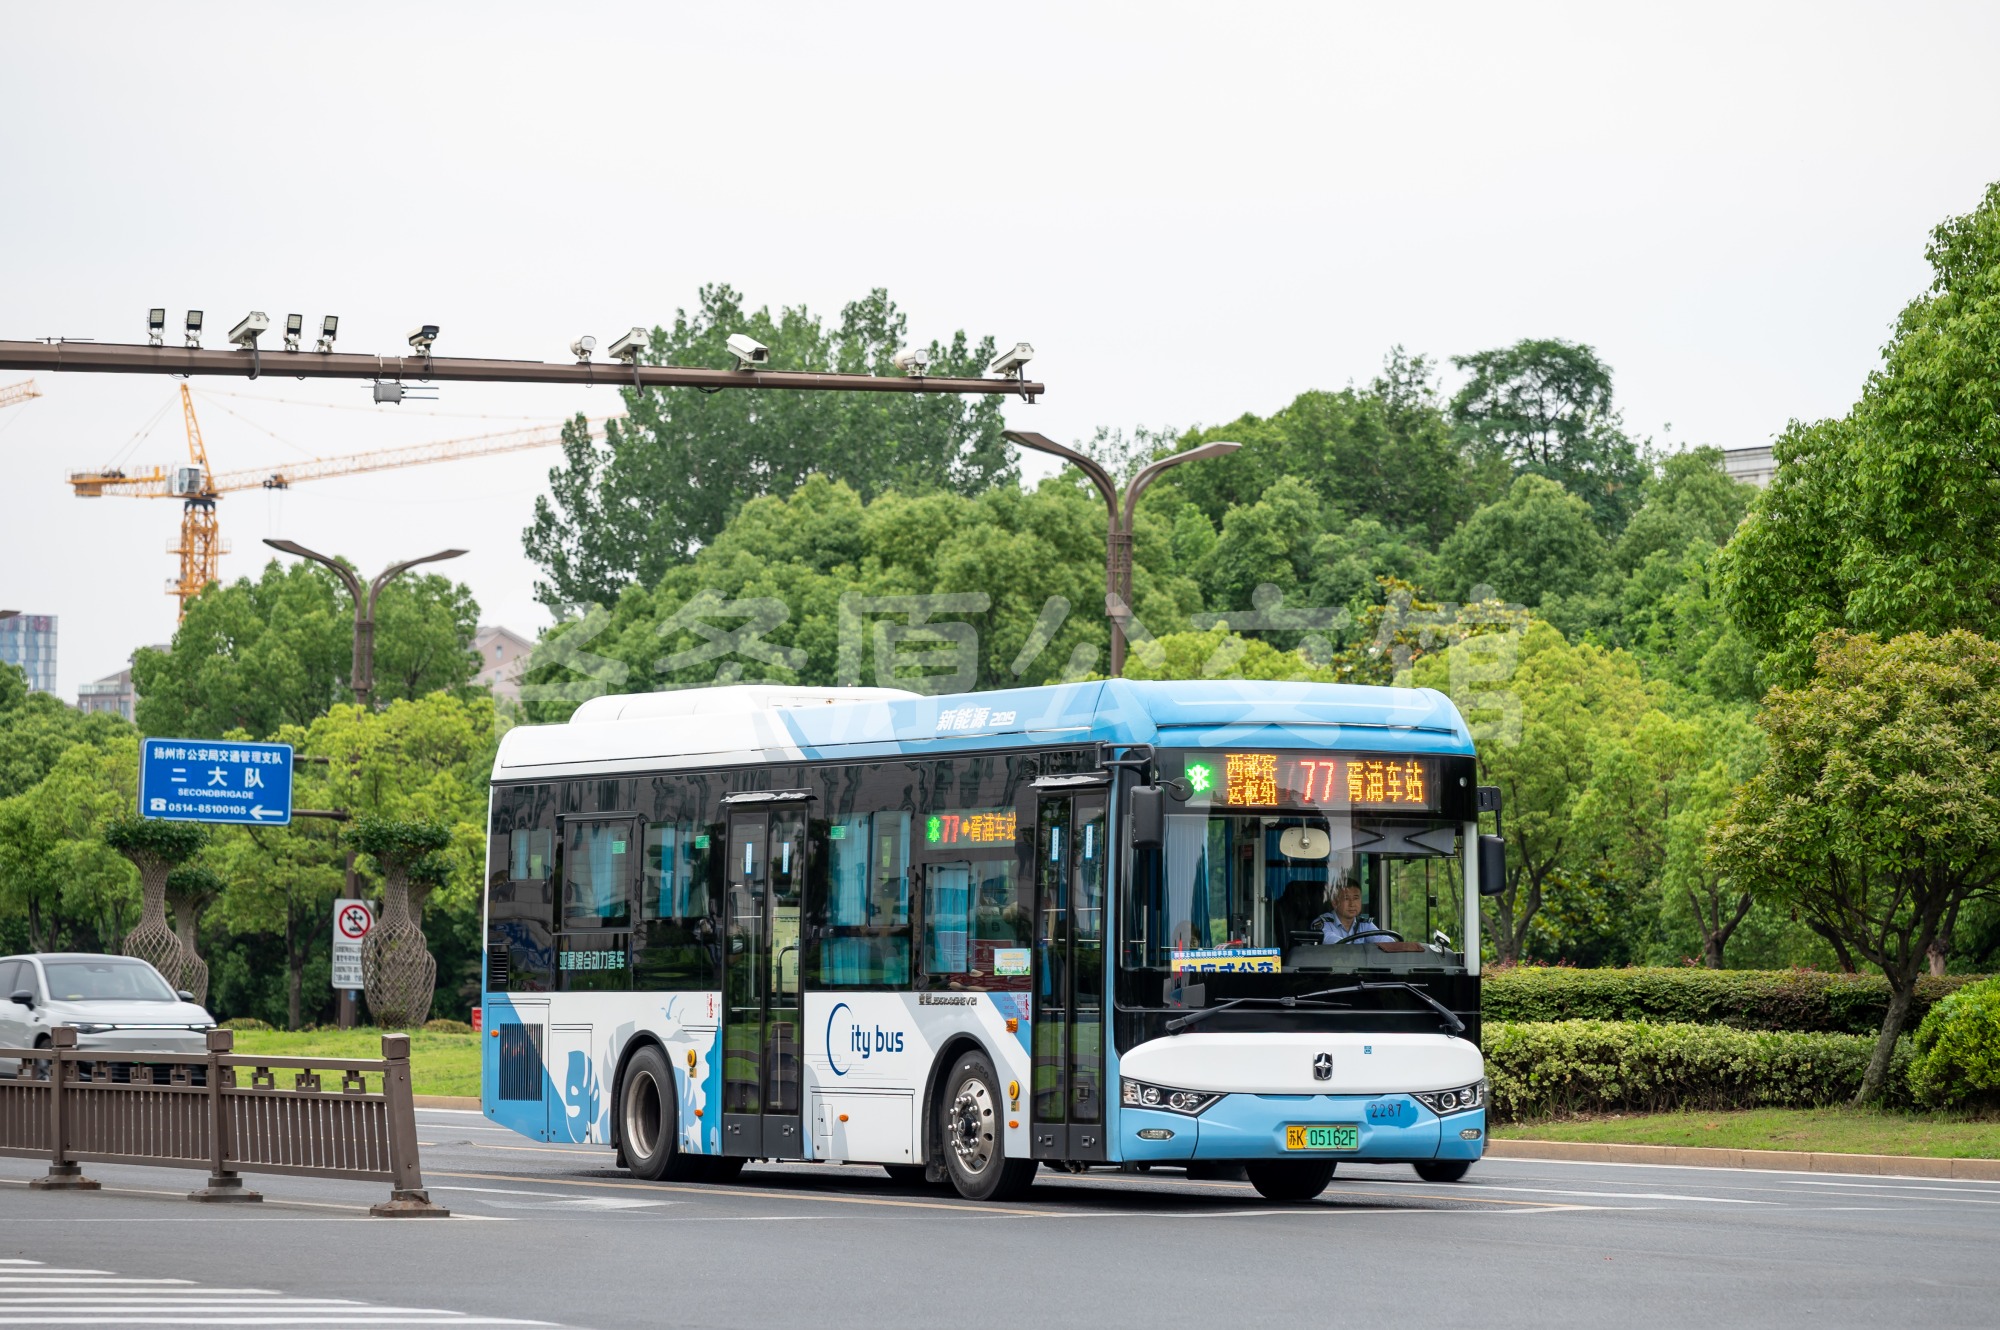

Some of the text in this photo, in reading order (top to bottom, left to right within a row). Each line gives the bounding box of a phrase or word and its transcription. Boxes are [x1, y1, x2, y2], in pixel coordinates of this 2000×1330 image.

[936, 707, 991, 731] 新能源
[153, 746, 283, 765] 扬州市公安局交通管理支队
[171, 766, 265, 789] 二大队
[1300, 761, 1334, 802] 77
[1346, 760, 1423, 803] 胥浦车站
[168, 803, 247, 815] 0514-85100105
[941, 815, 960, 843] 77
[559, 950, 625, 970] 亚星混合动力客车
[826, 1002, 904, 1077] City bus
[1371, 1103, 1402, 1118] 2287
